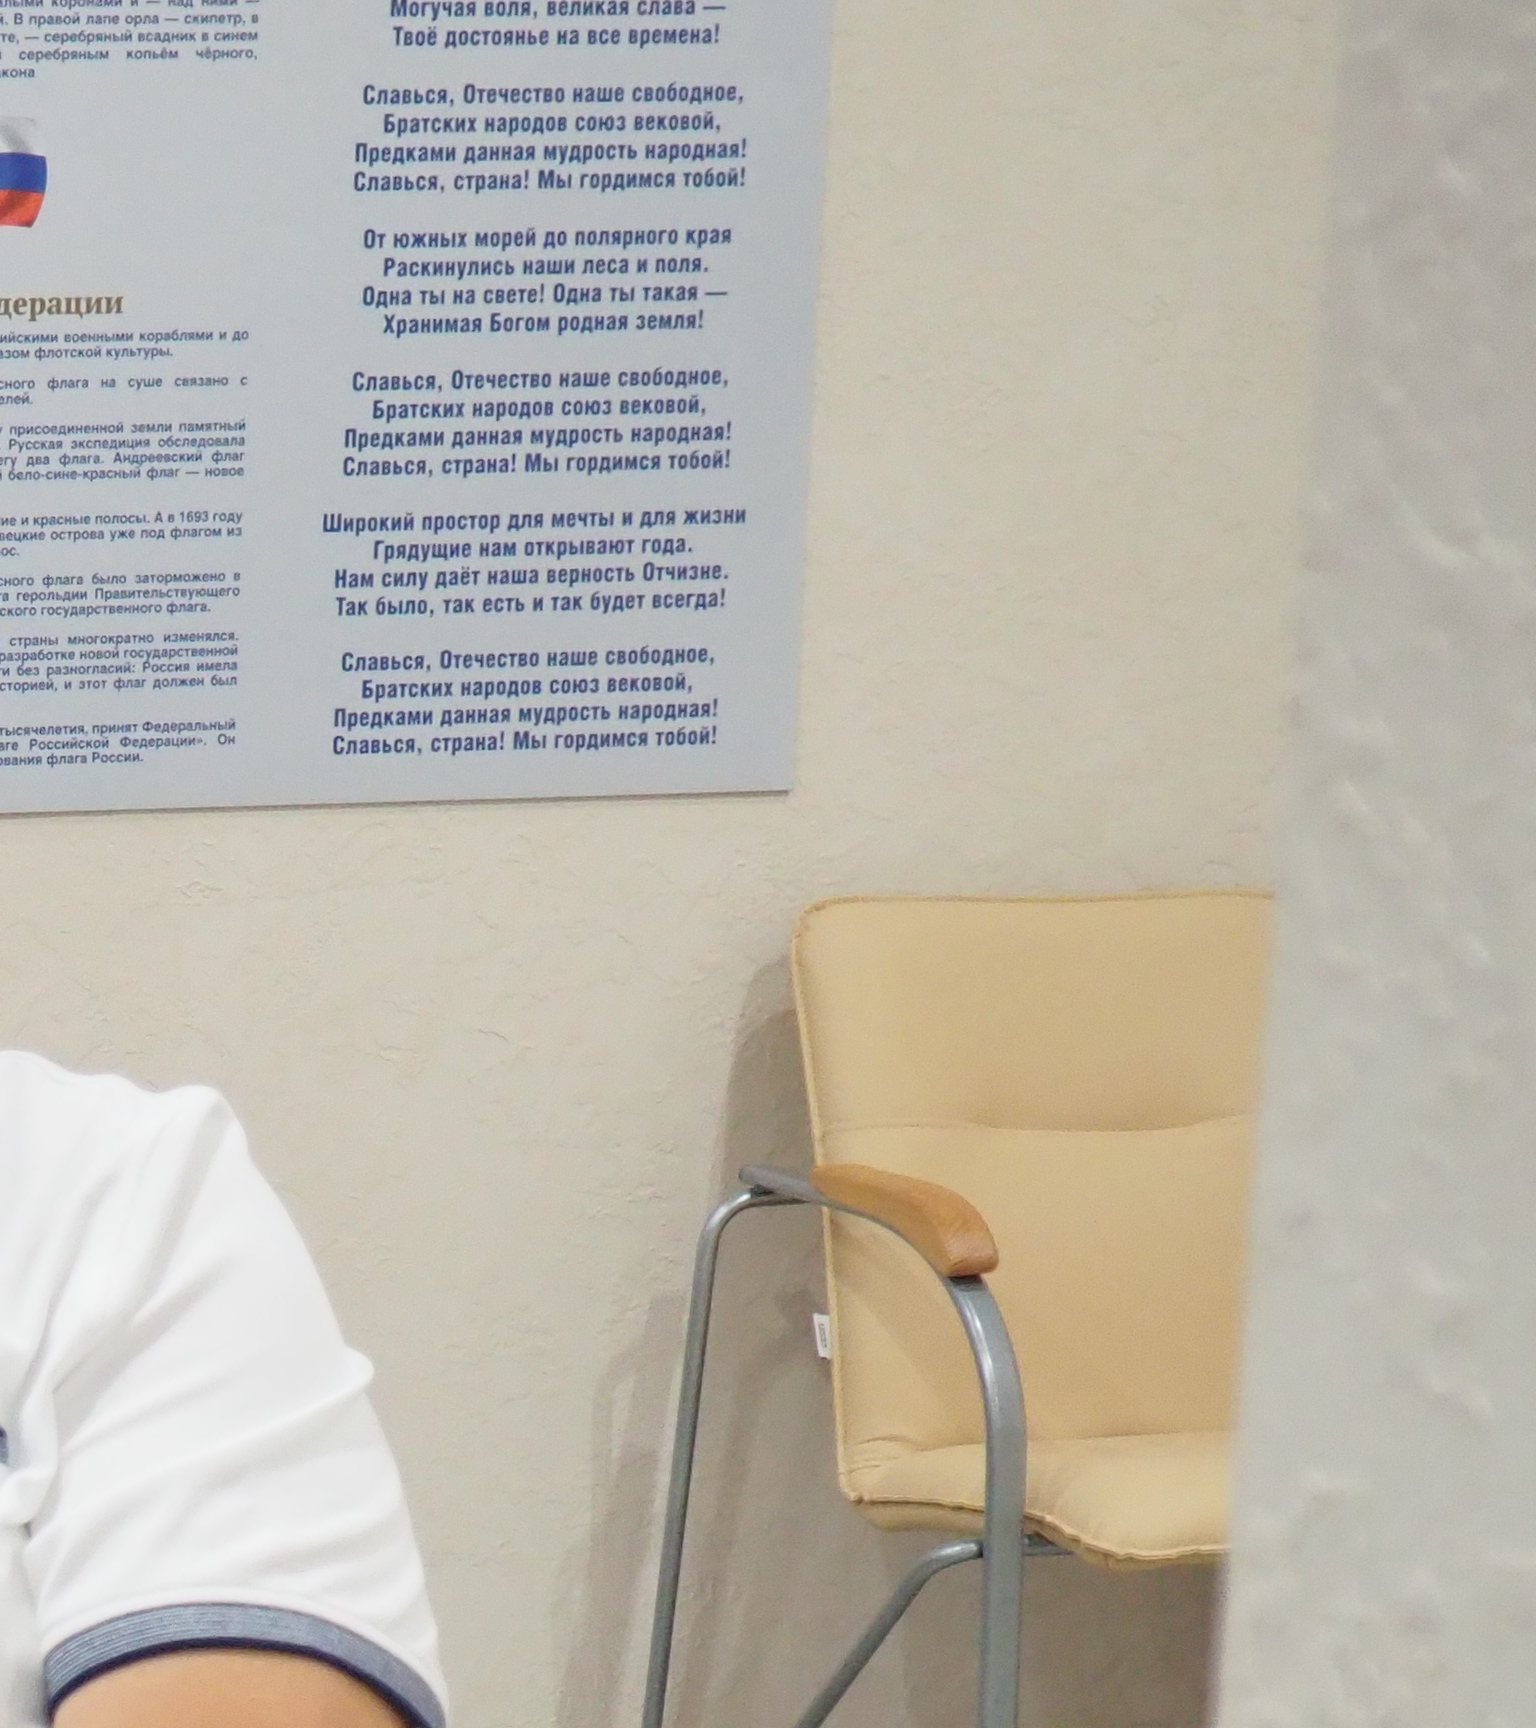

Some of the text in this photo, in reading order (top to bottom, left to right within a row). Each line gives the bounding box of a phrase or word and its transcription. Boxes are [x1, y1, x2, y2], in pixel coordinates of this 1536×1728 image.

[389, 0, 477, 22] Могучая
[483, 0, 538, 20] воля,
[546, 0, 630, 17] великая
[636, 0, 696, 17] слава
[392, 22, 720, 50] Твоё достоянье на все времена!
[18, 47, 110, 64] серебряным
[125, 46, 179, 61] копьём
[362, 81, 744, 108] Славься, Отечество наше свободное,
[383, 110, 721, 139] Братских народов союз вековой,
[354, 137, 747, 168] Предками данная мудрость народная!
[353, 166, 746, 195] Славься, страна! Мы гордимся тобой!
[363, 226, 732, 253] От южных морей до полярного края
[383, 257, 709, 281] Раскинулись наши леса и поля.
[362, 285, 412, 309] Одна
[419, 289, 446, 306] ты
[452, 288, 476, 305] на
[483, 282, 545, 305] свете!
[552, 282, 602, 306] Одна
[608, 286, 636, 303] ты
[642, 285, 699, 303] такая
[63, 332, 134, 344] военными
[138, 328, 214, 345] кораблями
[218, 331, 228, 341] и
[231, 330, 250, 343] до
[382, 308, 704, 339] Хранимая Богом родная земля!
[33, 345, 102, 362] флотской
[352, 366, 729, 393] Славься, Отечество наше свободное,
[372, 394, 706, 424] Братских народов союз вековой,
[344, 420, 732, 453] Предками данная мудрость народная!
[342, 448, 731, 479] Славься, страна! Мы гордимся тобой!
[322, 508, 747, 538] Широкий простор для мечты и для жизни
[372, 537, 693, 565] Грядущие нам открывают года.
[334, 561, 729, 592] Нам силу даёт наша верность Отчизне.
[335, 587, 726, 618] Так было, так есть и так будет всегда!
[341, 644, 715, 673] Славься, Отечество наше свободное,
[361, 672, 693, 704] Братских народов союз вековой,
[333, 697, 719, 732] Предками данная мудрость народная!
[332, 724, 717, 757] Славься, страна! Мы гордимся тобой!
[46, 752, 88, 769] флага
